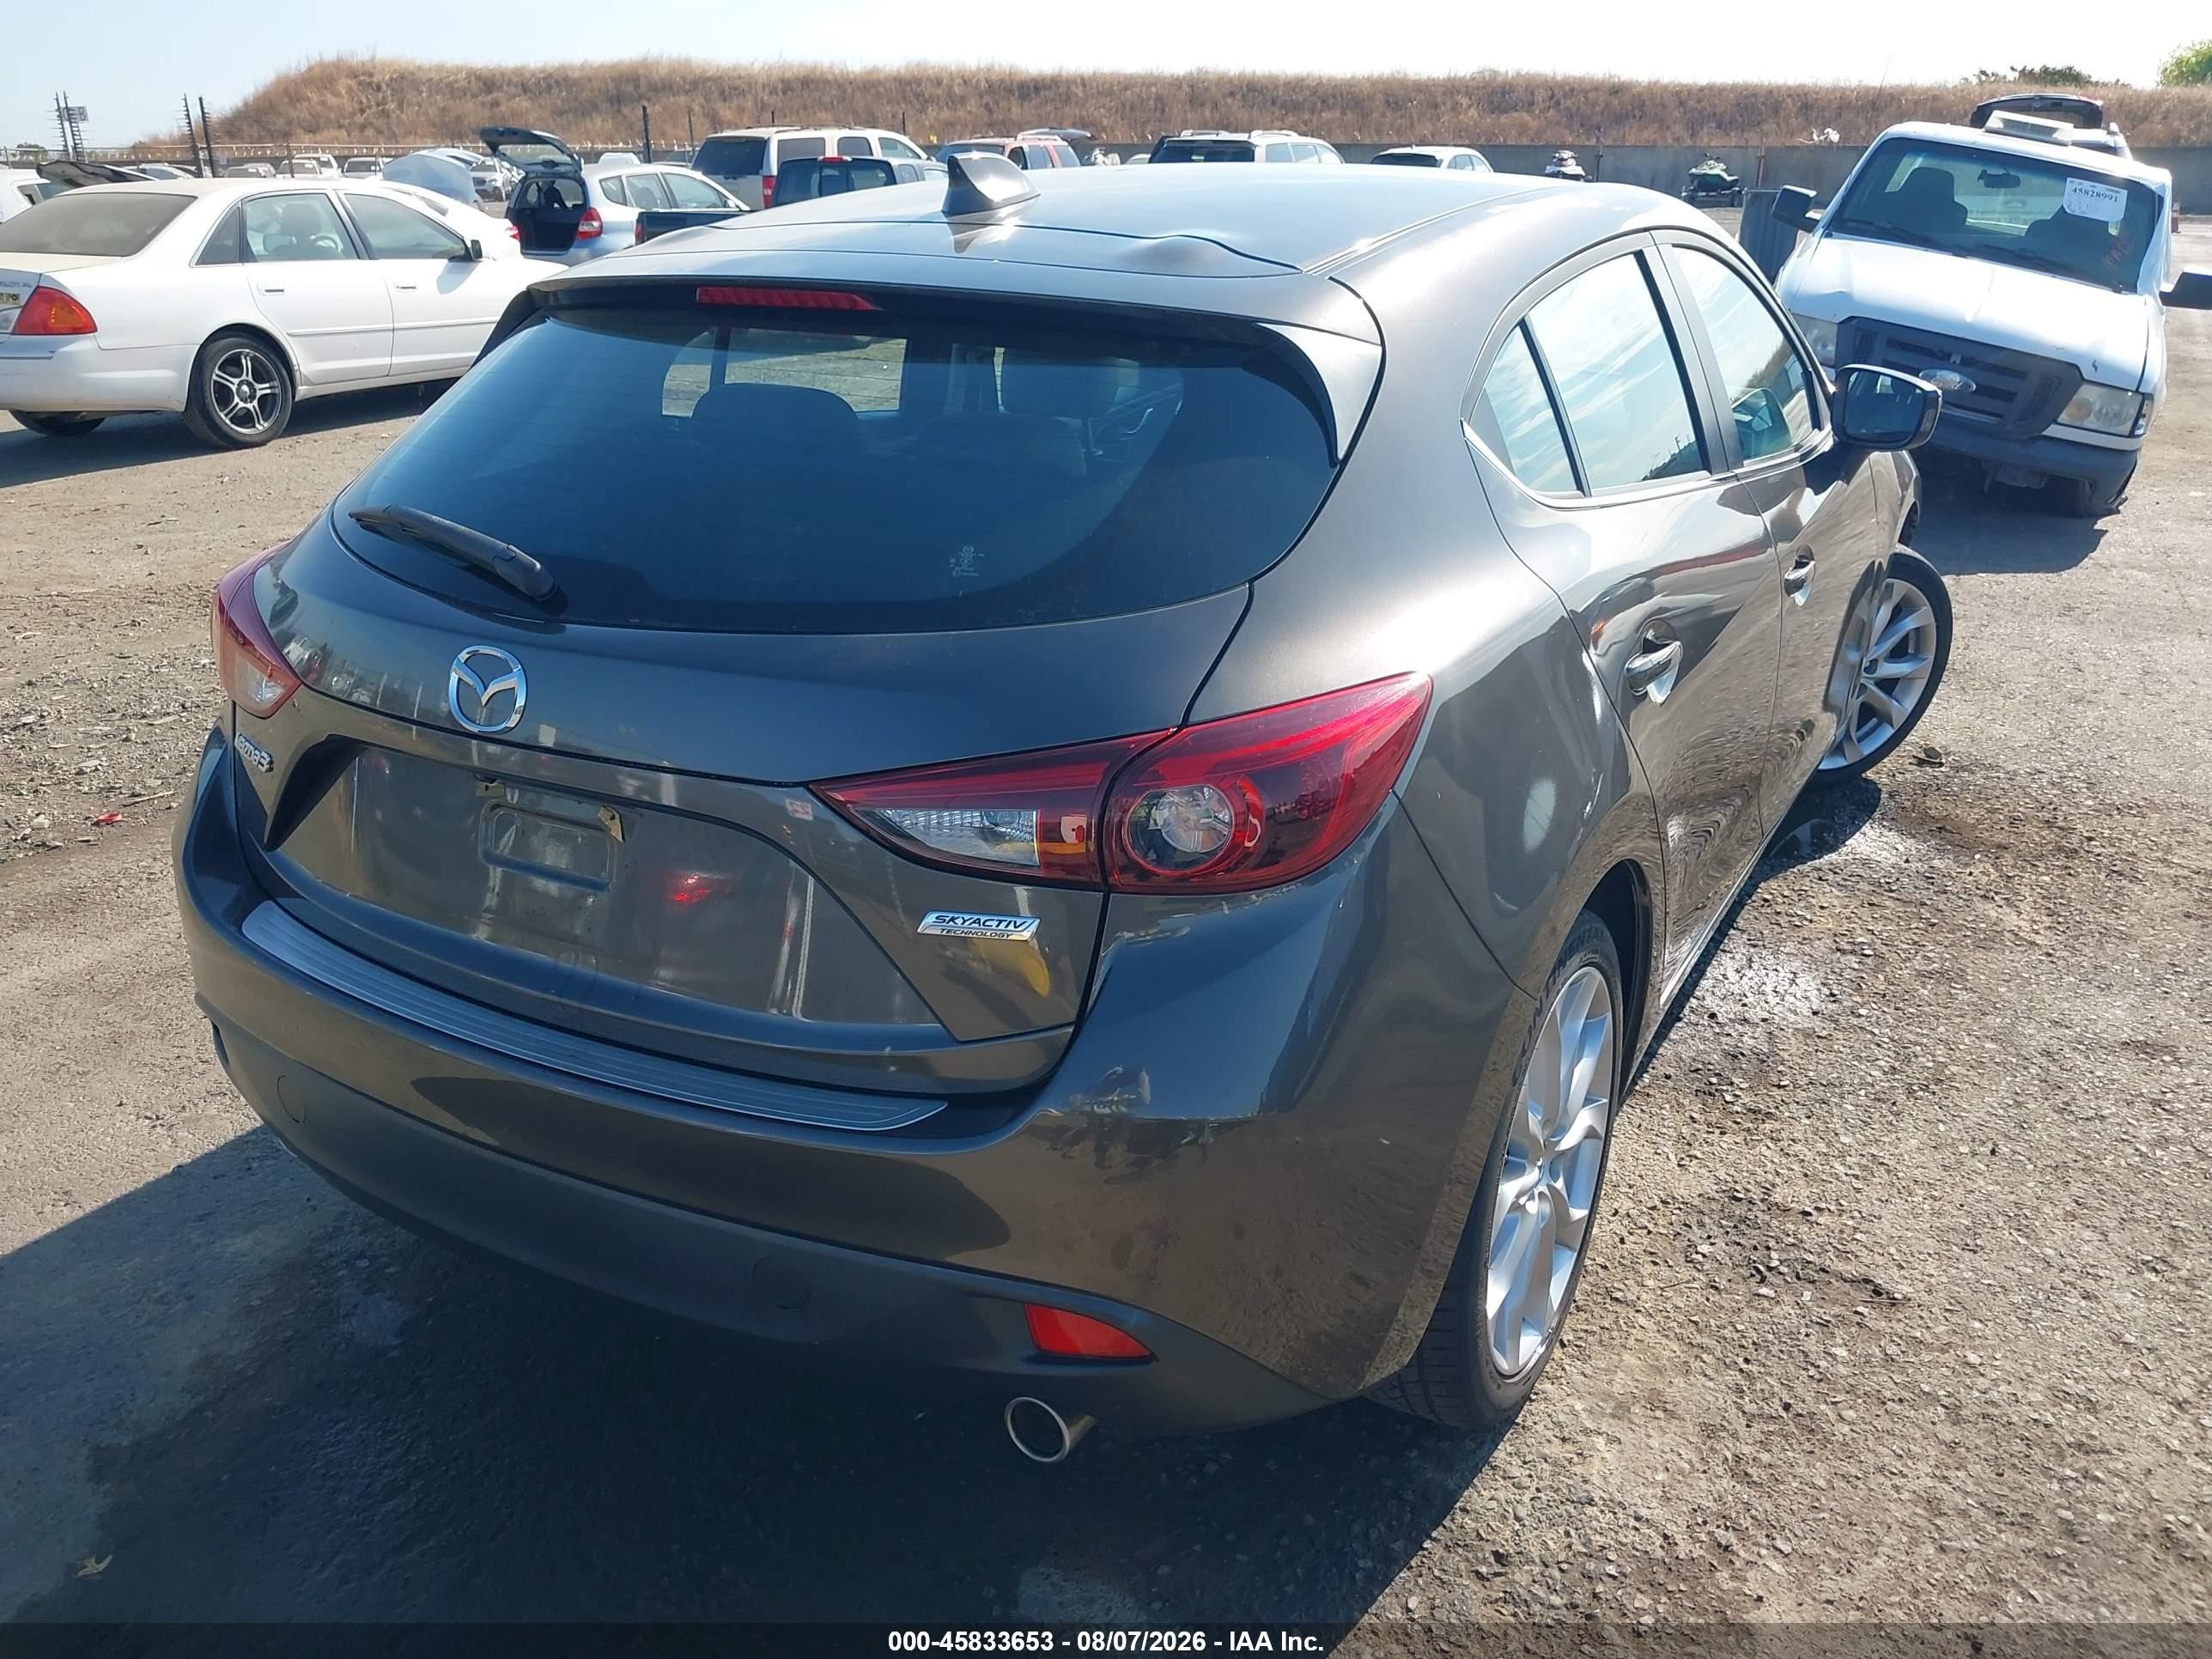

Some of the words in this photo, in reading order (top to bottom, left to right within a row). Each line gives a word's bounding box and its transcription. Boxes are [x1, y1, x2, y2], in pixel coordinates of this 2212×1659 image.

[2071, 186, 2118, 203] 45828991
[933, 915, 1027, 929] SKYACTIV
[939, 927, 1014, 939] TECHNOLOGY
